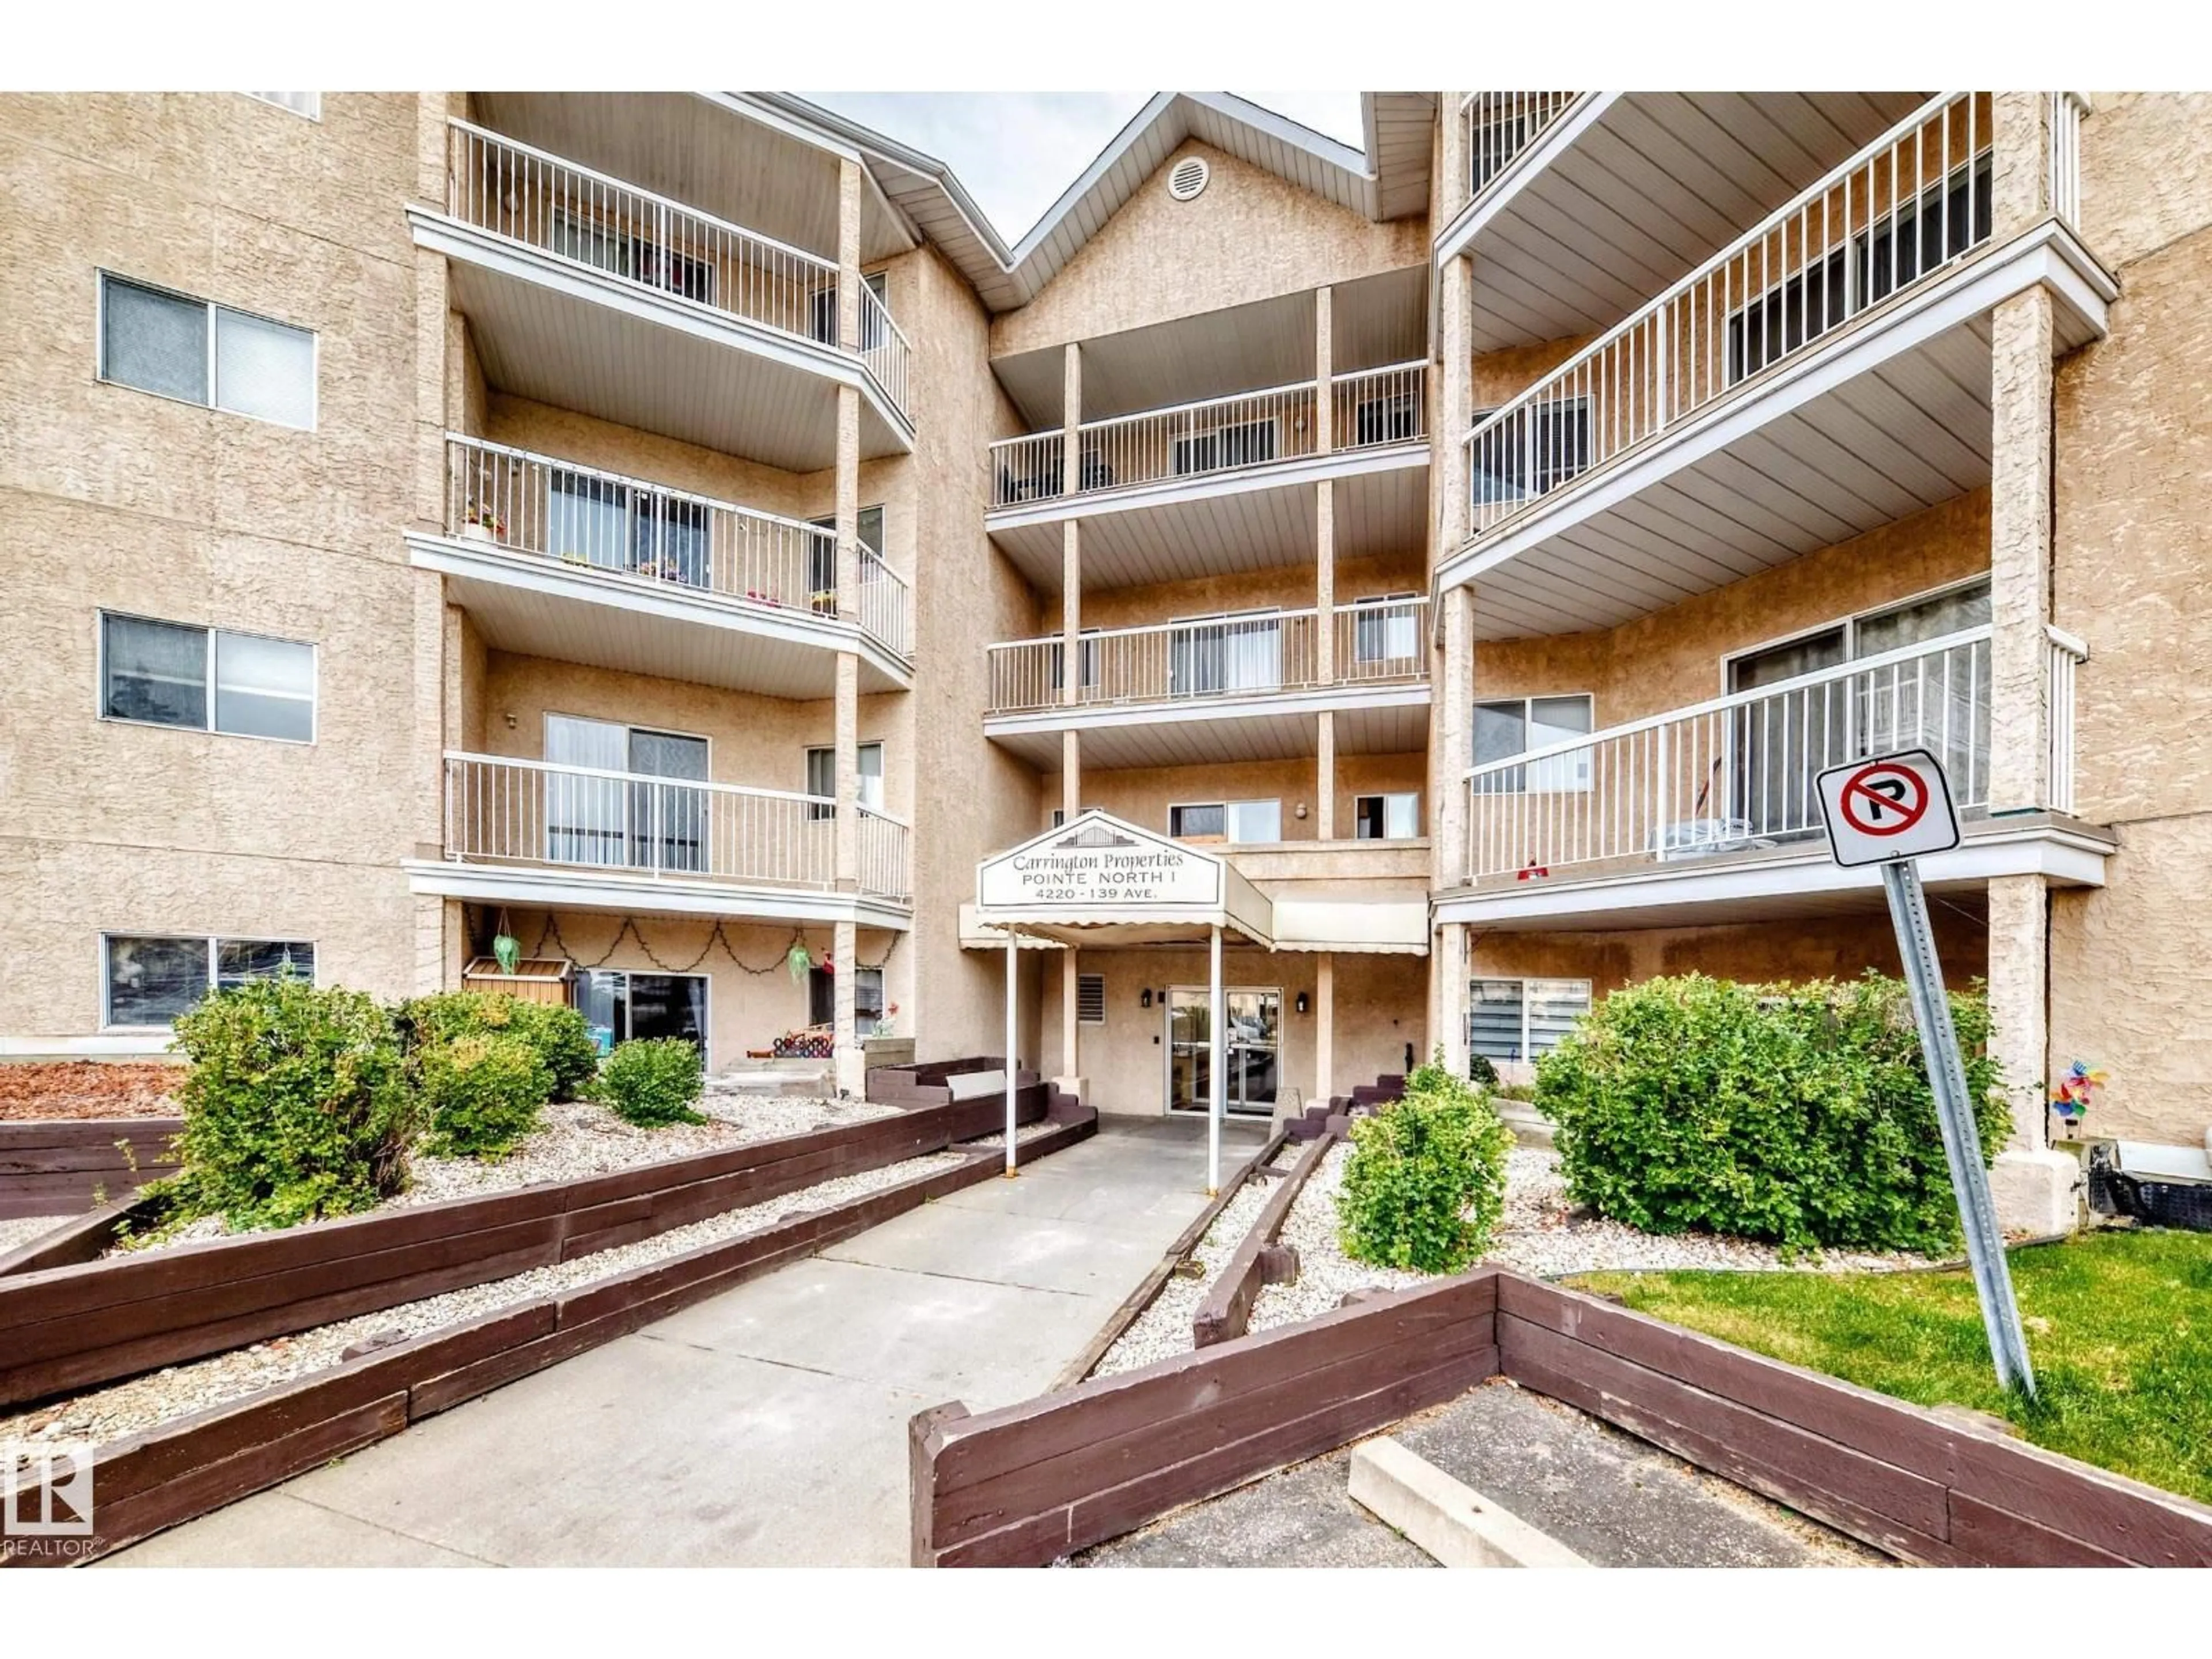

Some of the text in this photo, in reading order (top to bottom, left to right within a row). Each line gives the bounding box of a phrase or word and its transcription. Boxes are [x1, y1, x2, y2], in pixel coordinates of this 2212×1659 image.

[1013, 850, 1183, 872] Carrington Properties
[1022, 873, 1087, 885] POINTE
[1099, 872, 1163, 884] NORTH
[1036, 889, 1075, 899] 4220
[1090, 889, 1118, 899] 139
